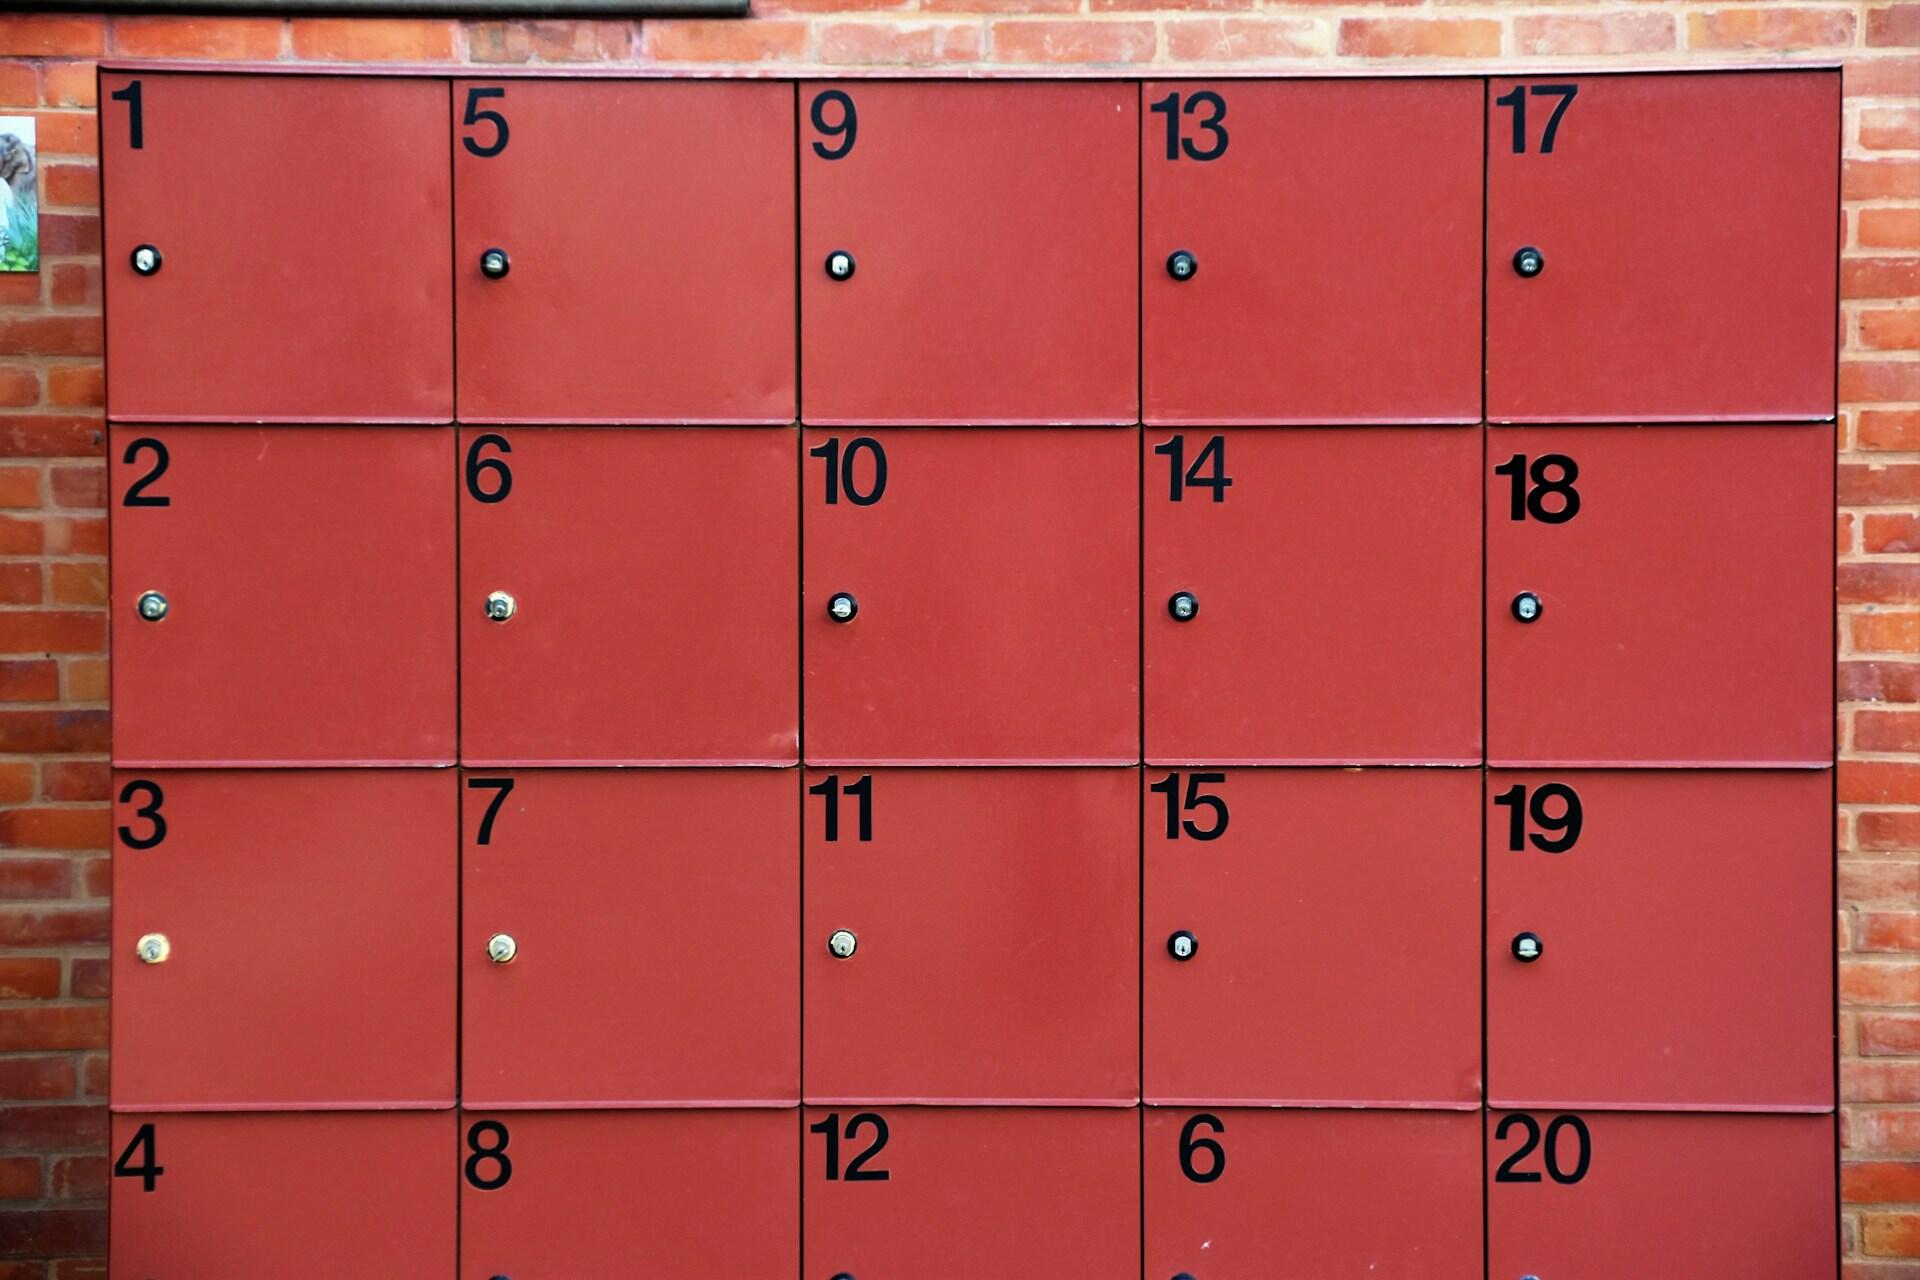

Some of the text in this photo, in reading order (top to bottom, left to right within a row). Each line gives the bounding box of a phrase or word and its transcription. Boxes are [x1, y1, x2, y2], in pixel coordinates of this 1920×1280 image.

[111, 79, 144, 150] 1
[463, 87, 510, 158] 5
[810, 89, 857, 161] 9
[1150, 90, 1229, 162] 13
[1496, 84, 1578, 154] 17
[123, 437, 171, 507] 2
[465, 433, 513, 504] 6
[810, 437, 888, 507] 10
[1154, 434, 1233, 503] 14
[1495, 454, 1581, 525] 18
[118, 779, 168, 850] 3
[467, 777, 515, 846] 7
[809, 774, 872, 842] 11
[1150, 772, 1230, 841] 15
[1494, 783, 1583, 854] 19
[113, 1122, 165, 1193] 4
[464, 1119, 513, 1191] 8
[810, 1112, 890, 1182] 12
[1178, 1112, 1226, 1184] 6
[1495, 1113, 1591, 1185] 20
